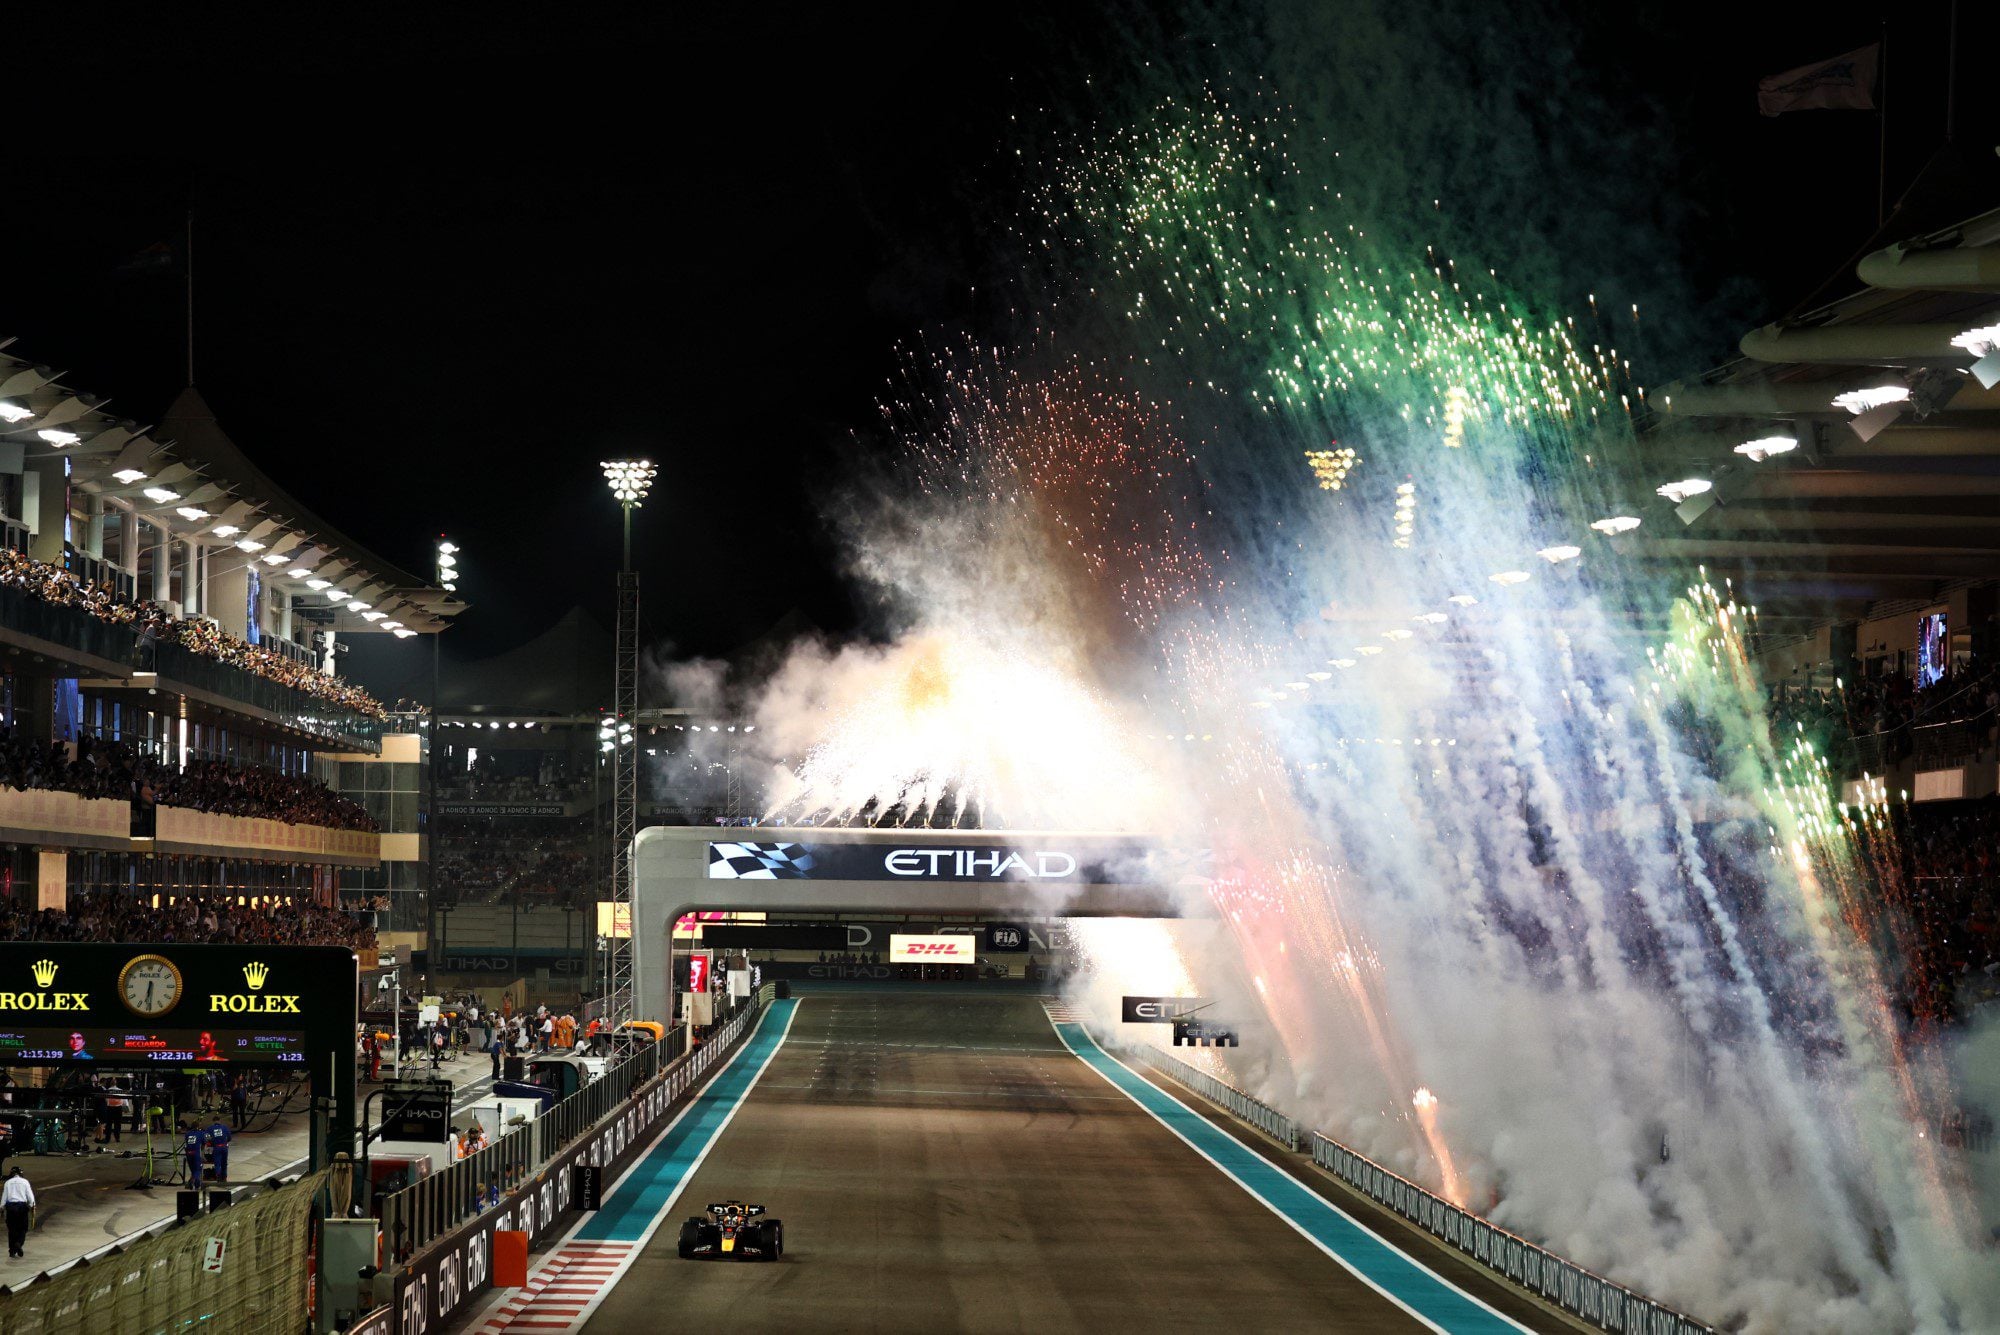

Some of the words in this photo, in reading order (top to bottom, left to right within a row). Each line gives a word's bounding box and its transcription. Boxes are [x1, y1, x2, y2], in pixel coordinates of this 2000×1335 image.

[885, 850, 1076, 878] ETIHAD
[907, 944, 959, 955] DHL
[436, 957, 509, 970] TIHAD
[808, 965, 890, 978] ETIHAD
[0, 992, 90, 1011] ROLEX
[209, 995, 301, 1013] ROLEX
[109, 1037, 116, 1045] 9
[18, 1050, 63, 1059] +1:15.199
[147, 1051, 193, 1060] +1:22.316
[583, 1168, 592, 1209] ETIHAD
[439, 1248, 461, 1318] ETIHAD
